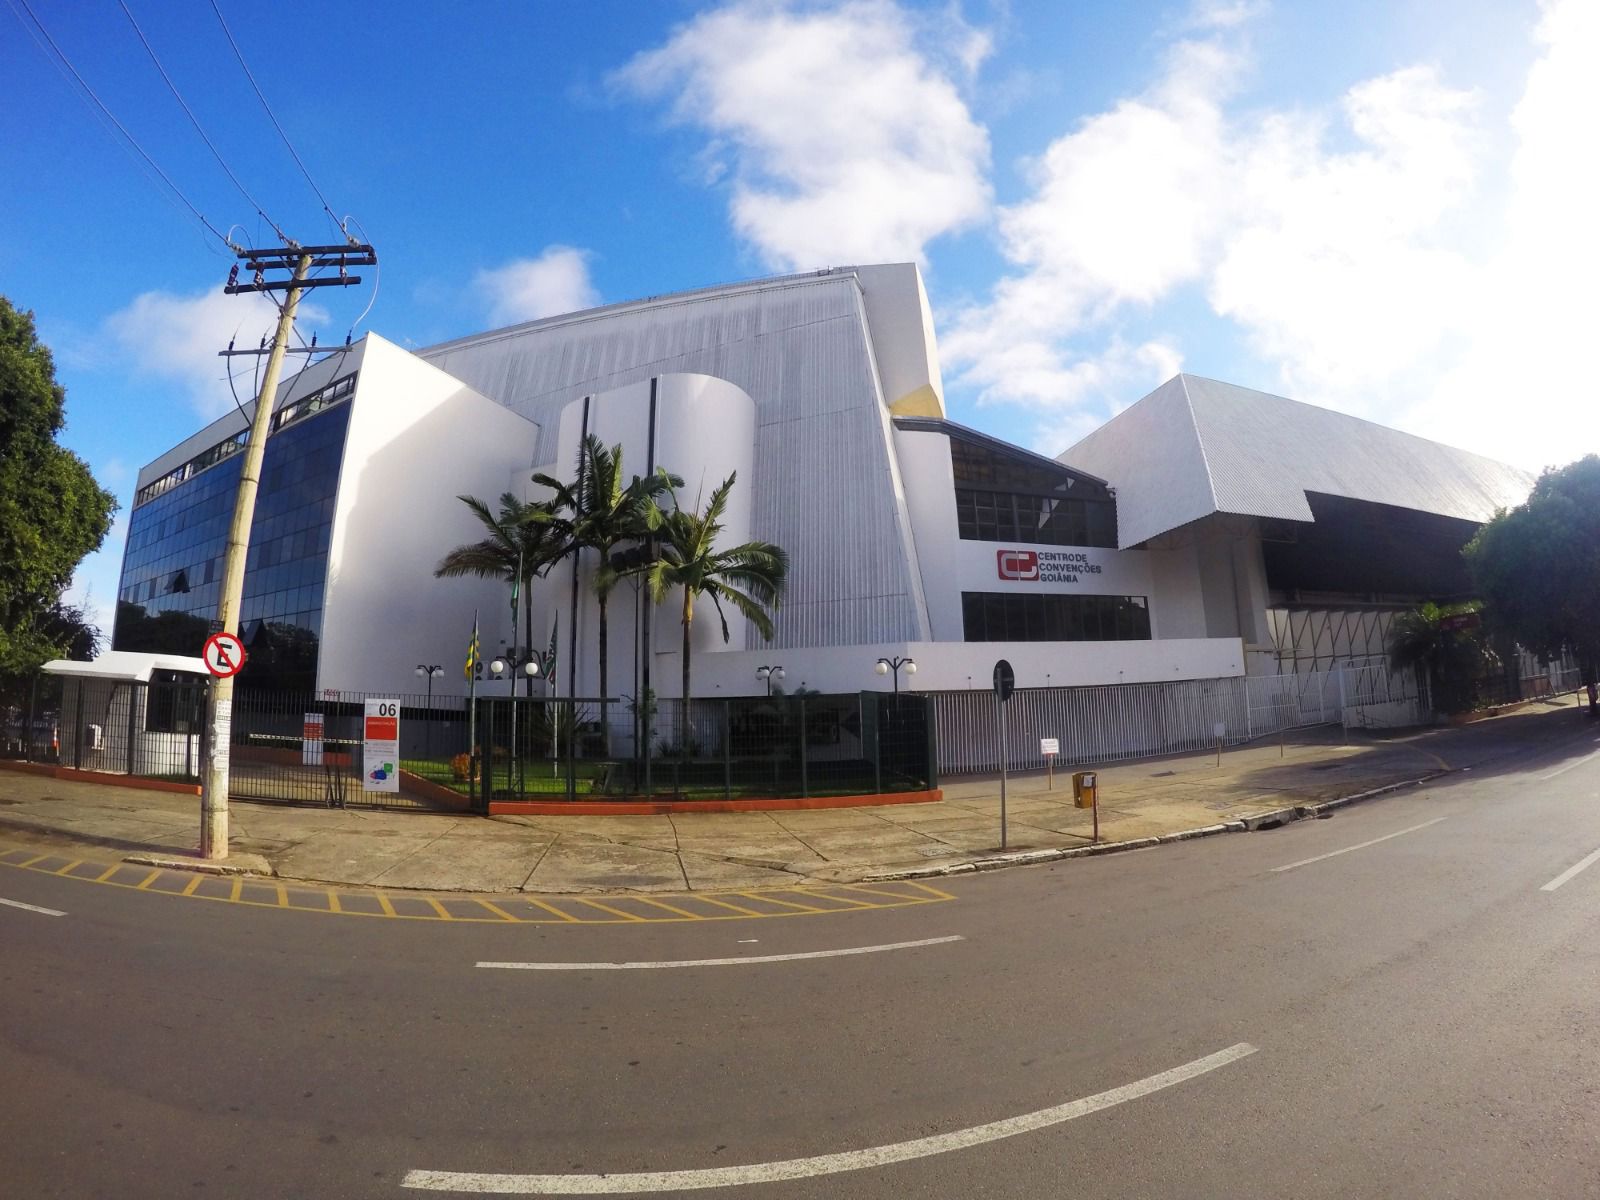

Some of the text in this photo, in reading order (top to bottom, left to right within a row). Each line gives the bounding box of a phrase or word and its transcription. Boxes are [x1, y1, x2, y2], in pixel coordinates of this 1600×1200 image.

[1038, 552, 1087, 563] CENTRO DE
[1039, 563, 1102, 574] CONVENÇÕES
[1040, 573, 1079, 583] GOIÂNIA
[217, 643, 232, 667] E
[379, 703, 396, 717] 06
